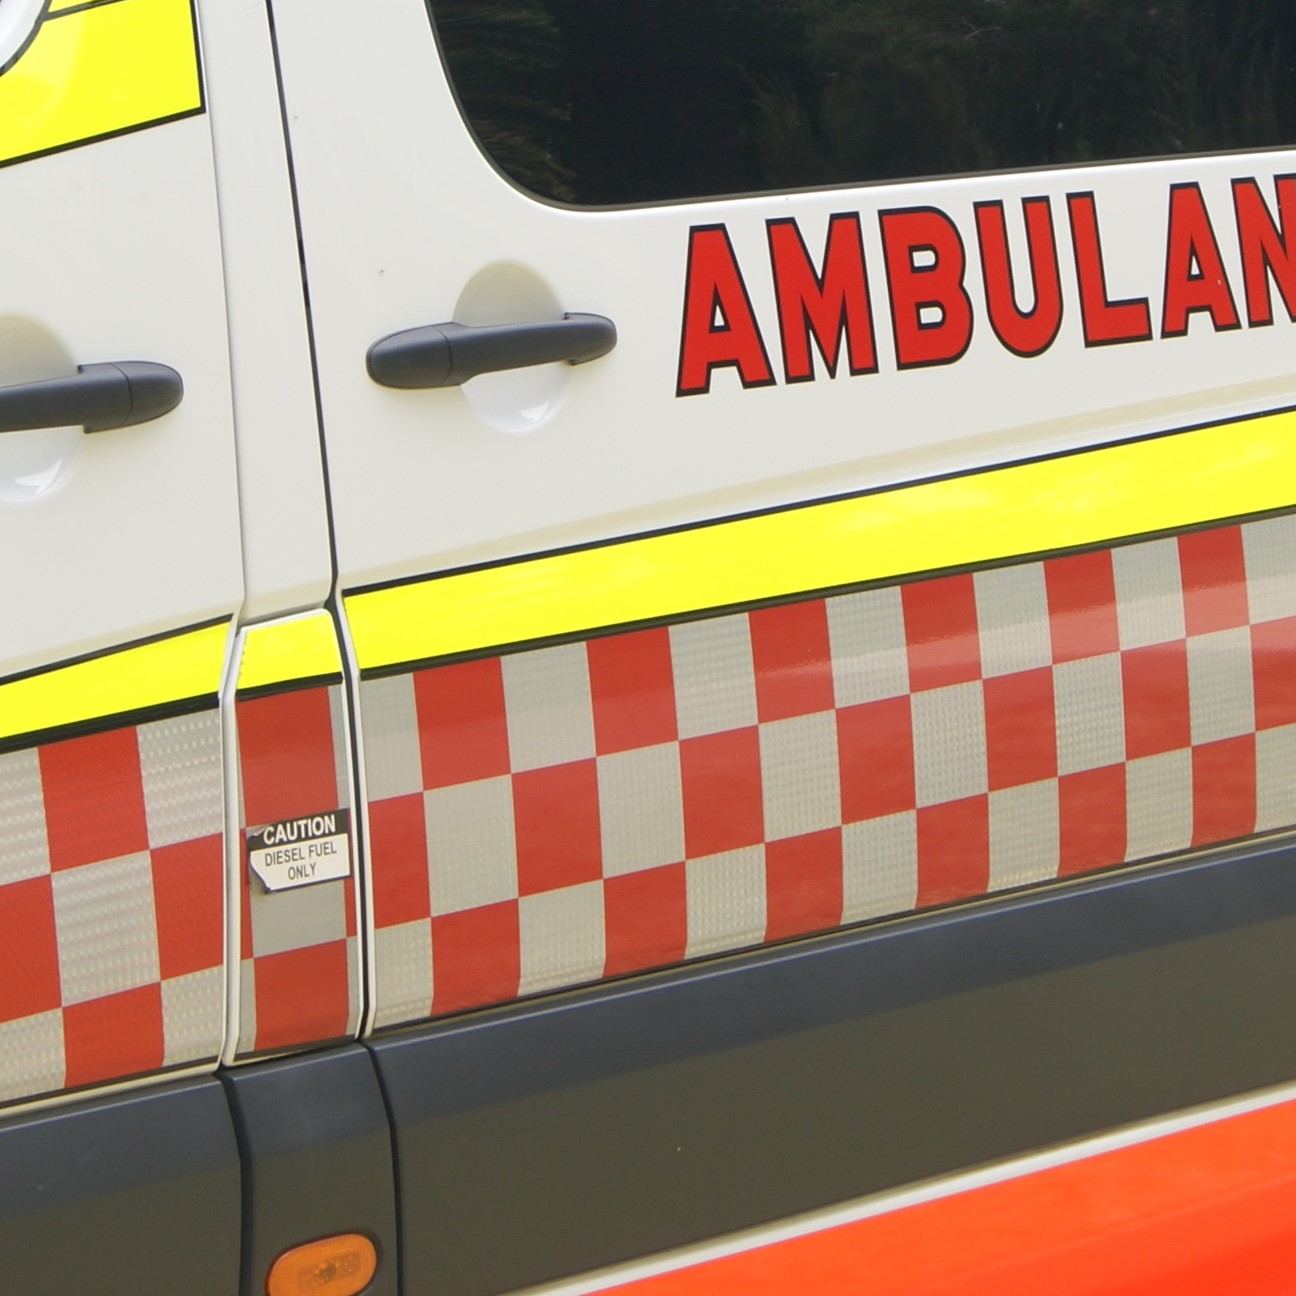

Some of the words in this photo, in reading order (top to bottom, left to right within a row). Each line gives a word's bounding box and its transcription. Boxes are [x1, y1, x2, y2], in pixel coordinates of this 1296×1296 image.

[263, 814, 336, 845] CAUTION
[264, 847, 305, 867] DIESEL
[308, 841, 337, 858] FUEL
[287, 862, 317, 880] ONLY
